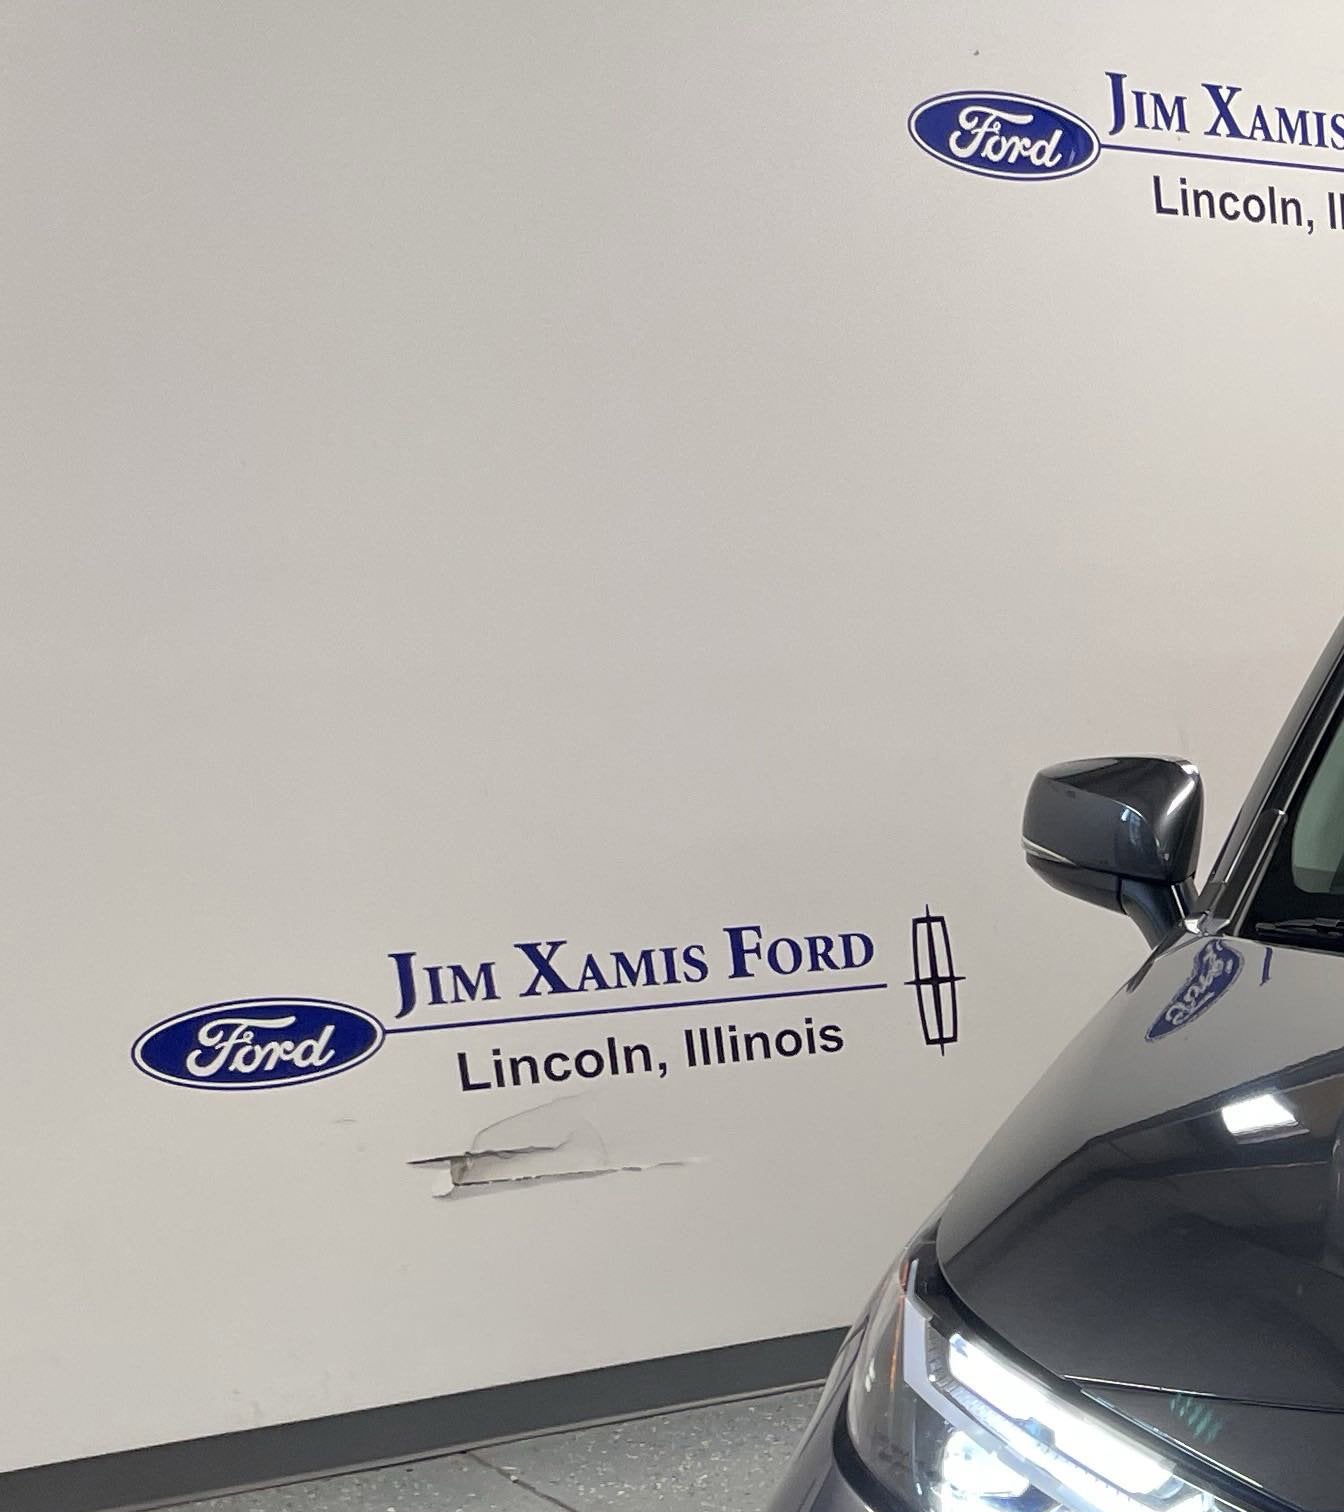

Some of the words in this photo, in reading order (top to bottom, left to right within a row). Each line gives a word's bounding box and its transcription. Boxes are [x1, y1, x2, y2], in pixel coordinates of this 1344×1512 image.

[1105, 72, 1189, 136] JIM
[950, 105, 1062, 170] Ford
[1153, 175, 1316, 235] Lincoln,
[388, 952, 495, 1019] JIM
[513, 940, 708, 997] XAMIS
[723, 926, 874, 978] FORD
[187, 1016, 334, 1078] Ford
[457, 1037, 667, 1092] Lincoln,
[685, 1018, 844, 1068] Illinois
